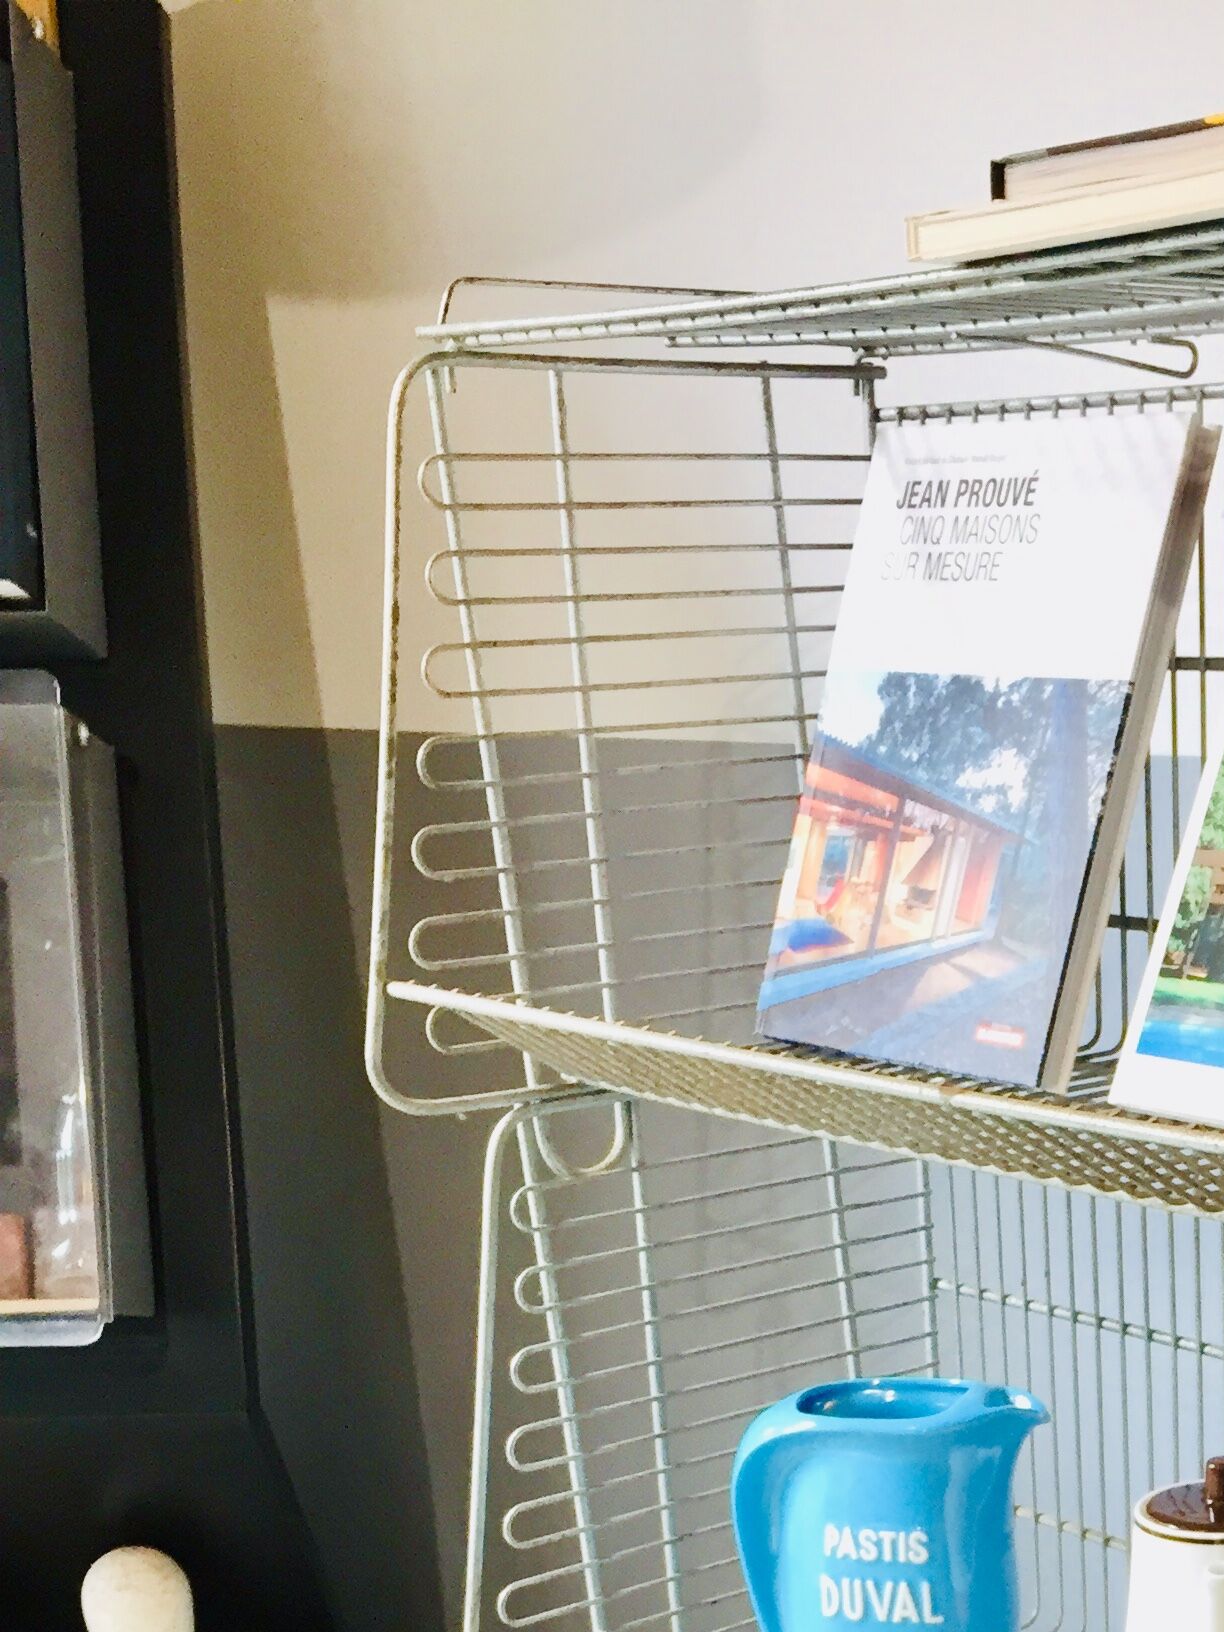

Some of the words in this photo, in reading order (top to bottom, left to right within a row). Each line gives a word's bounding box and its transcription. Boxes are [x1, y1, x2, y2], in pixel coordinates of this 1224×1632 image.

[896, 479, 951, 509] JEAN
[954, 469, 1040, 509] PROUVÉ
[900, 515, 945, 545] CINQ
[950, 513, 1041, 545] MAISONS
[923, 551, 1004, 582] MESURE
[823, 1523, 930, 1565] PASTIS
[819, 1573, 945, 1624] DUVAL
